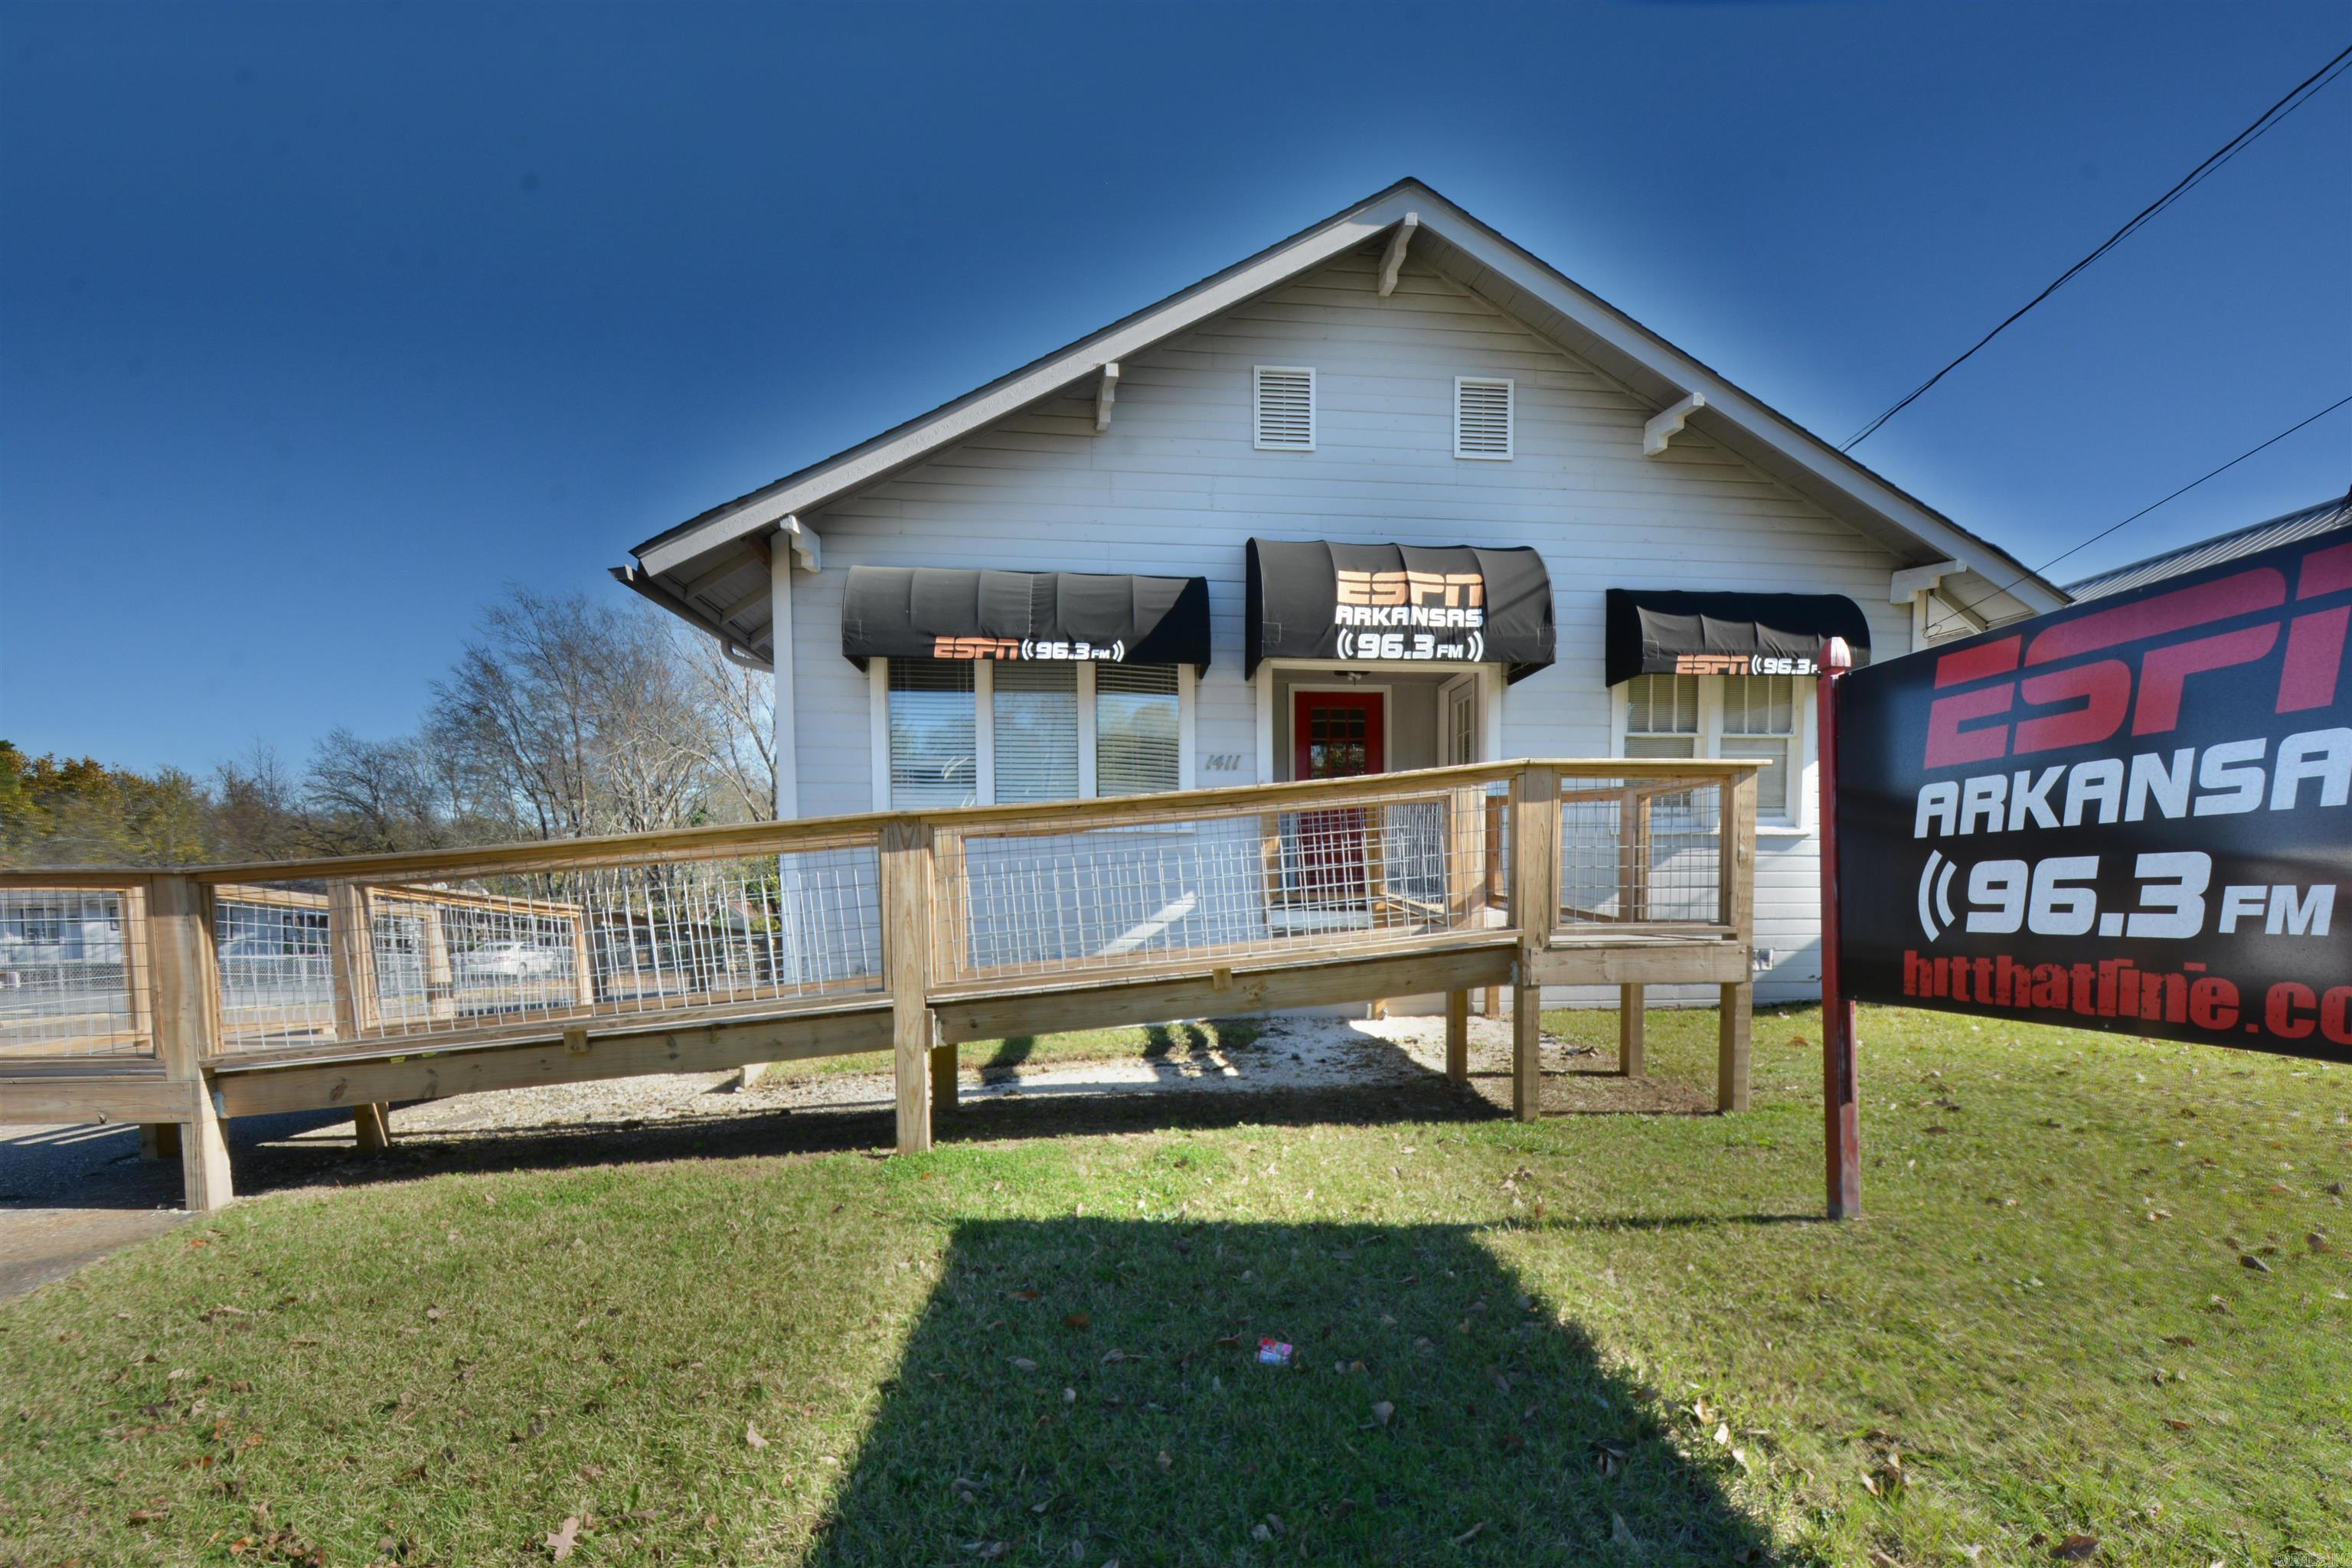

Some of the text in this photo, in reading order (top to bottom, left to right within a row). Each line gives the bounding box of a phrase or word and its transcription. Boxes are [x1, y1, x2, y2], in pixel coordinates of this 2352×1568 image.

[1338, 570, 1483, 606] ESPN
[1334, 605, 1483, 627] ARKANSAS
[933, 636, 1110, 661] ESPN 96.3 FM
[1357, 633, 1464, 659] 96.3 FM
[1675, 655, 1821, 675] ESPN 96.3 F
[1205, 754, 1241, 771] 1411
[1966, 851, 2336, 939] 96.3 FM
